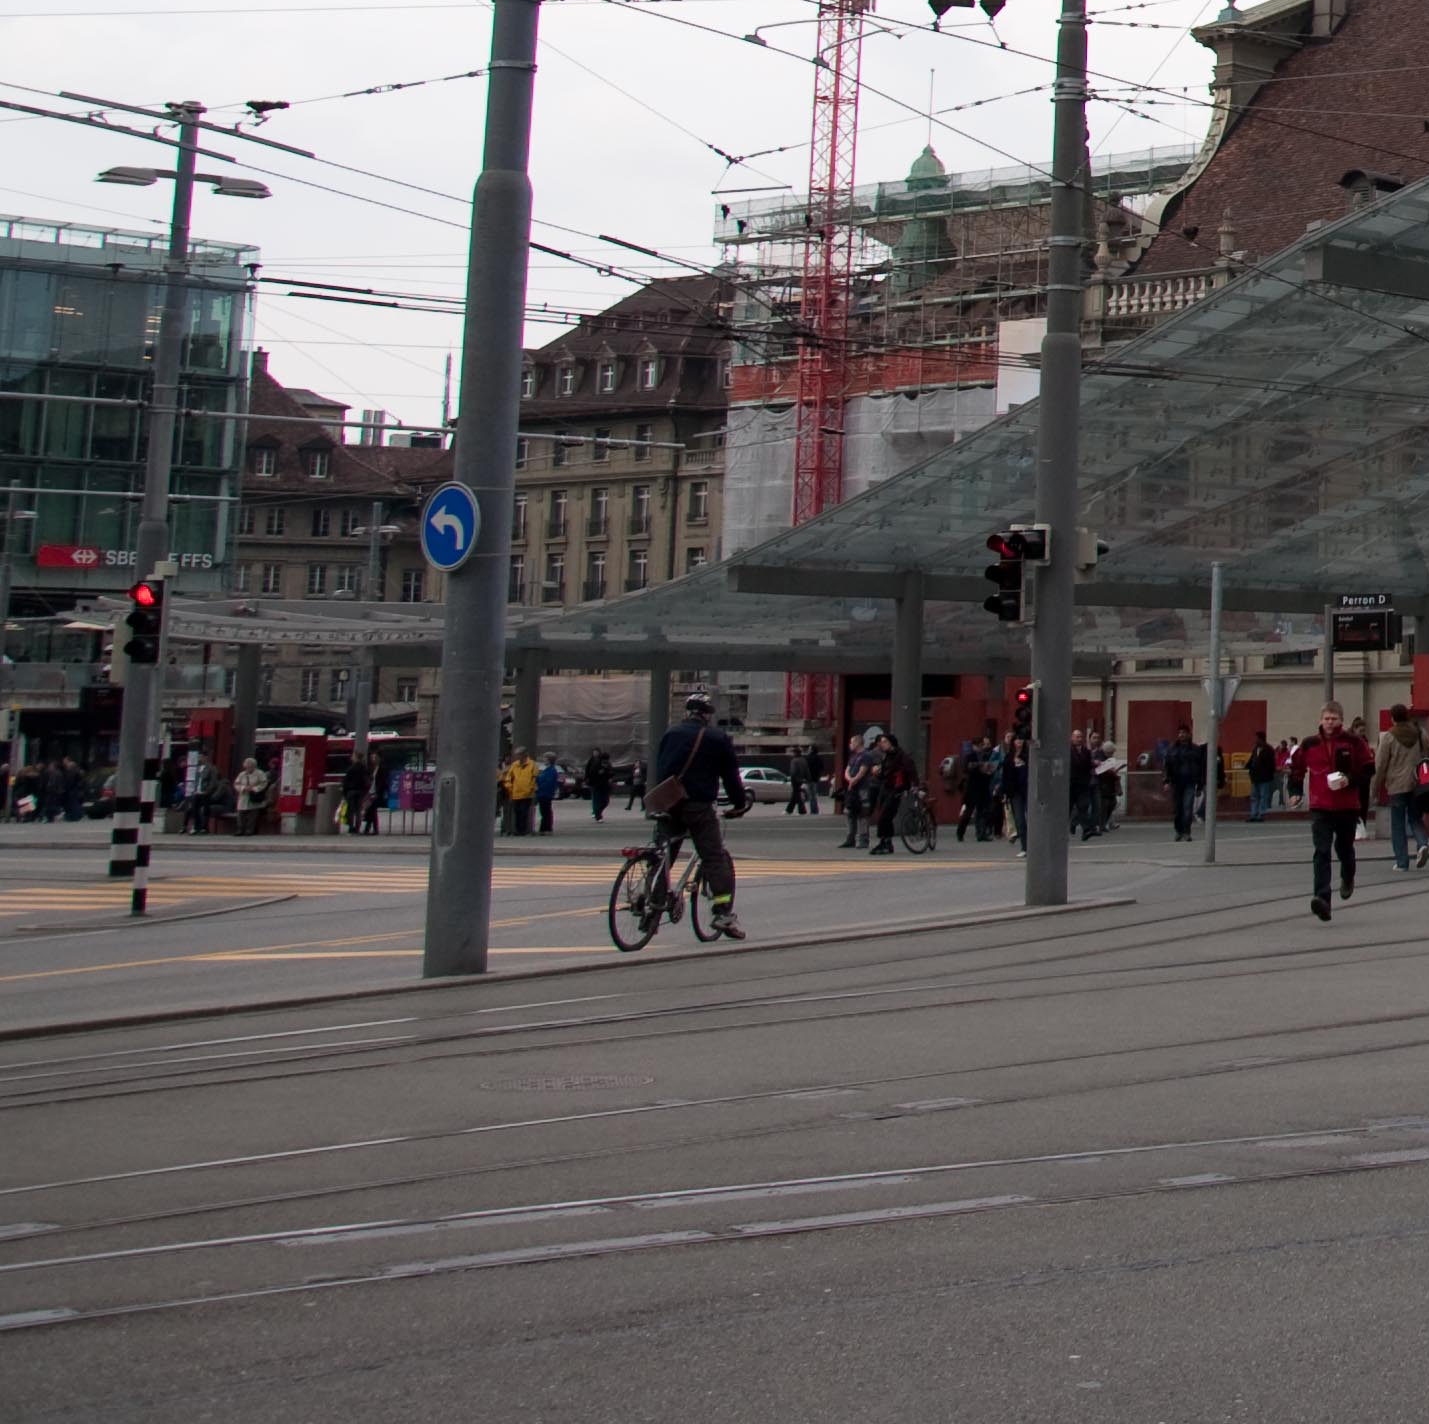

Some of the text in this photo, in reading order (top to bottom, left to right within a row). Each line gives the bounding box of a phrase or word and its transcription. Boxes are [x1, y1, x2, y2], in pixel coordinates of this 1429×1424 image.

[181, 553, 212, 568] FFS
[1342, 595, 1386, 605] Perron D
